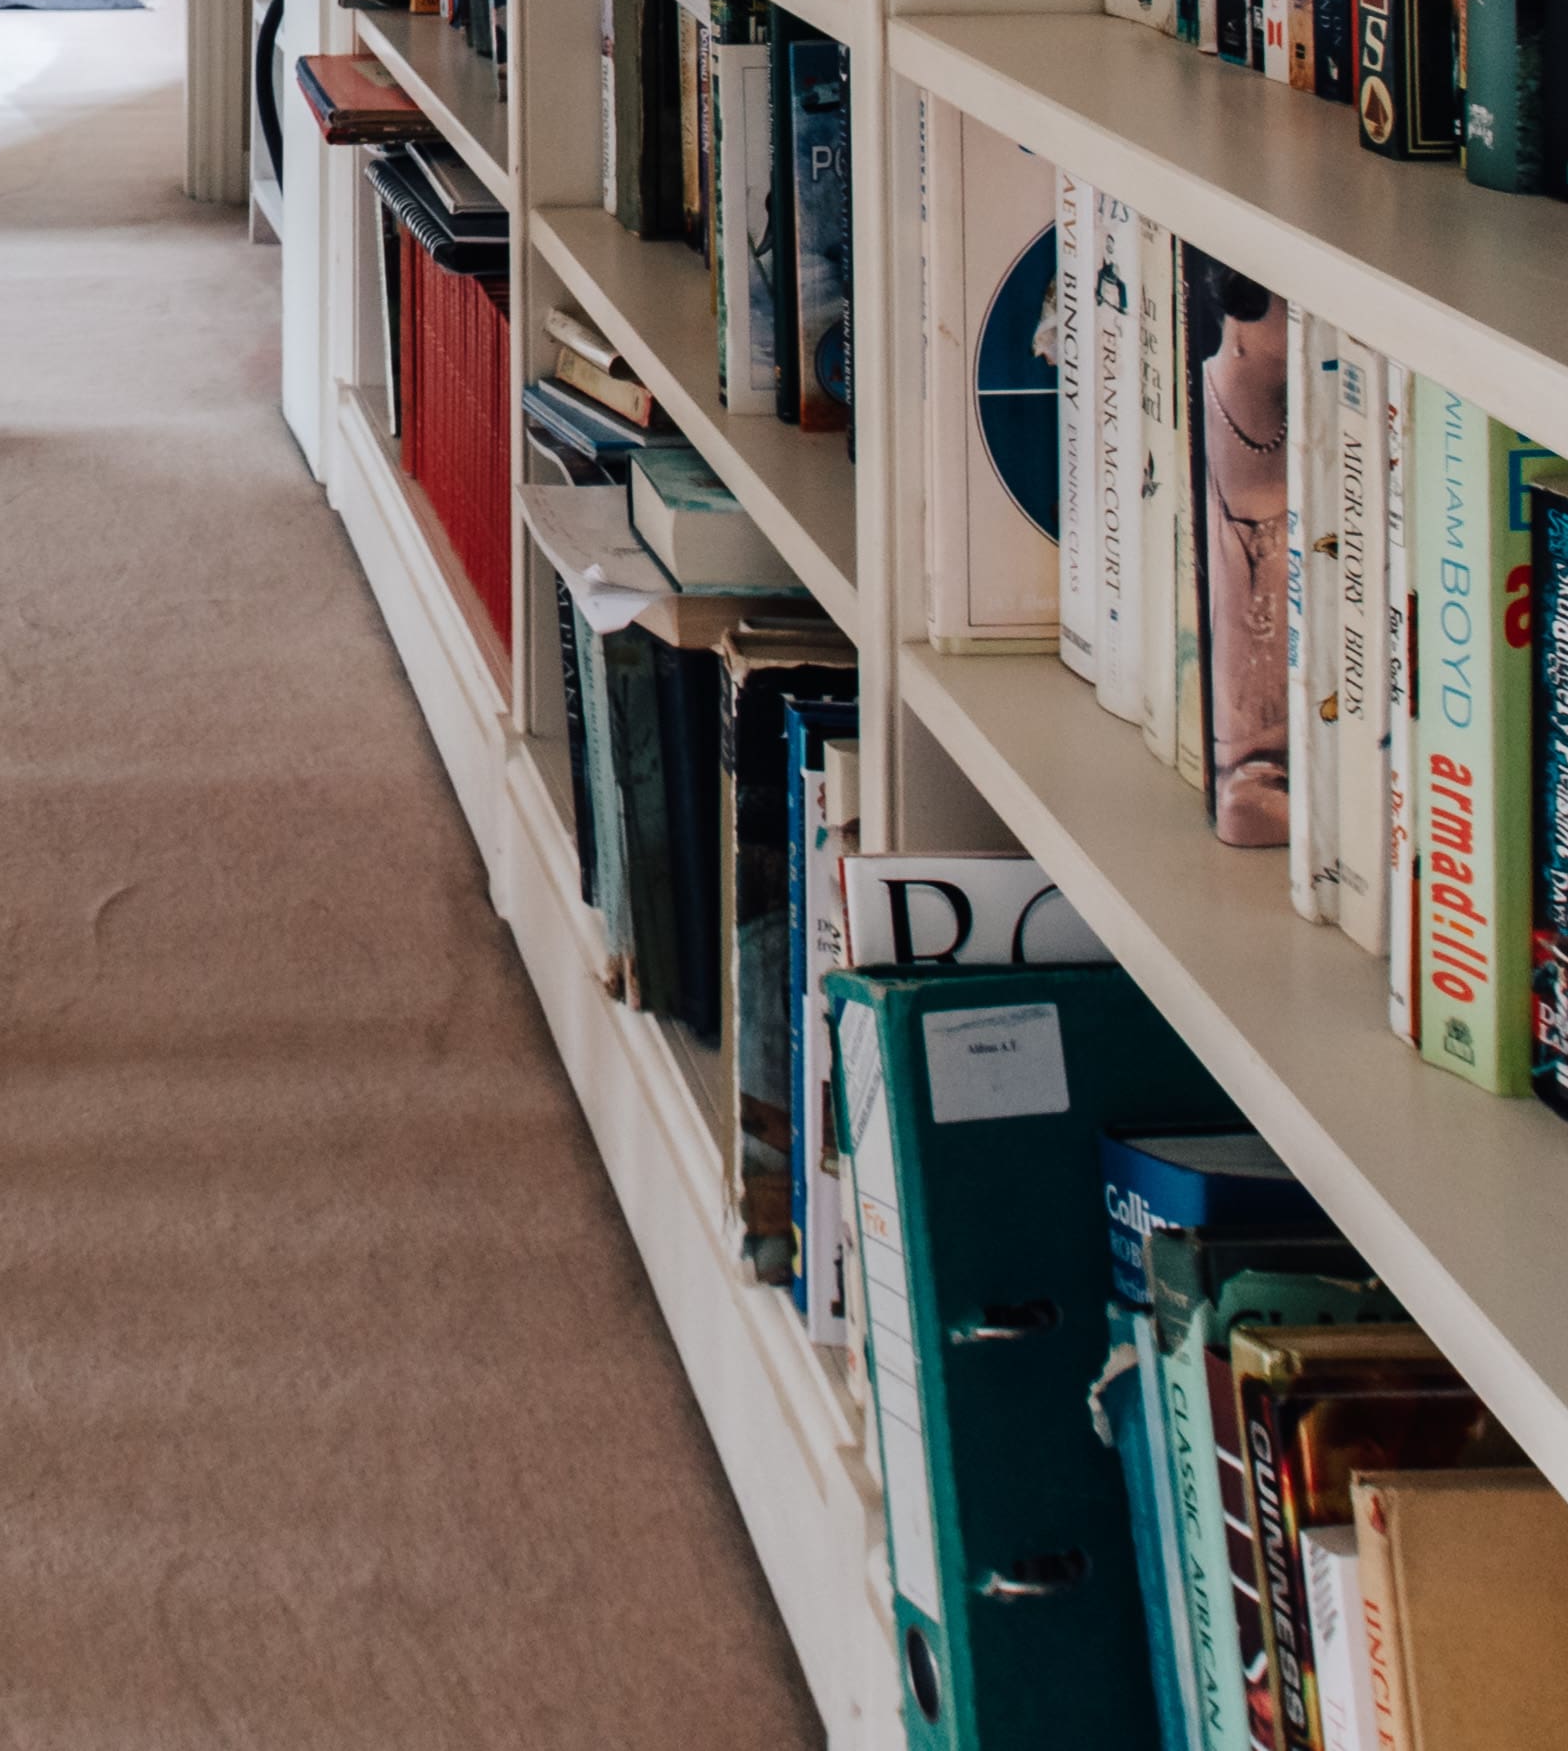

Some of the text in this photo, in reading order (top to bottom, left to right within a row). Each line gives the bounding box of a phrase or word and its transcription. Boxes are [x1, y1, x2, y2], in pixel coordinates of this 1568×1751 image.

[1063, 271, 1081, 411] BINCHY
[1102, 328, 1119, 426] FRANK
[1343, 431, 1365, 722] MIGRATORY BIRDS
[1440, 390, 1473, 729] WILLIAM BOYD
[1430, 753, 1491, 1004] armadillo
[1172, 1383, 1224, 1732] CLASSIC AFRICAN
[1250, 1420, 1306, 1729] GUINNESS
